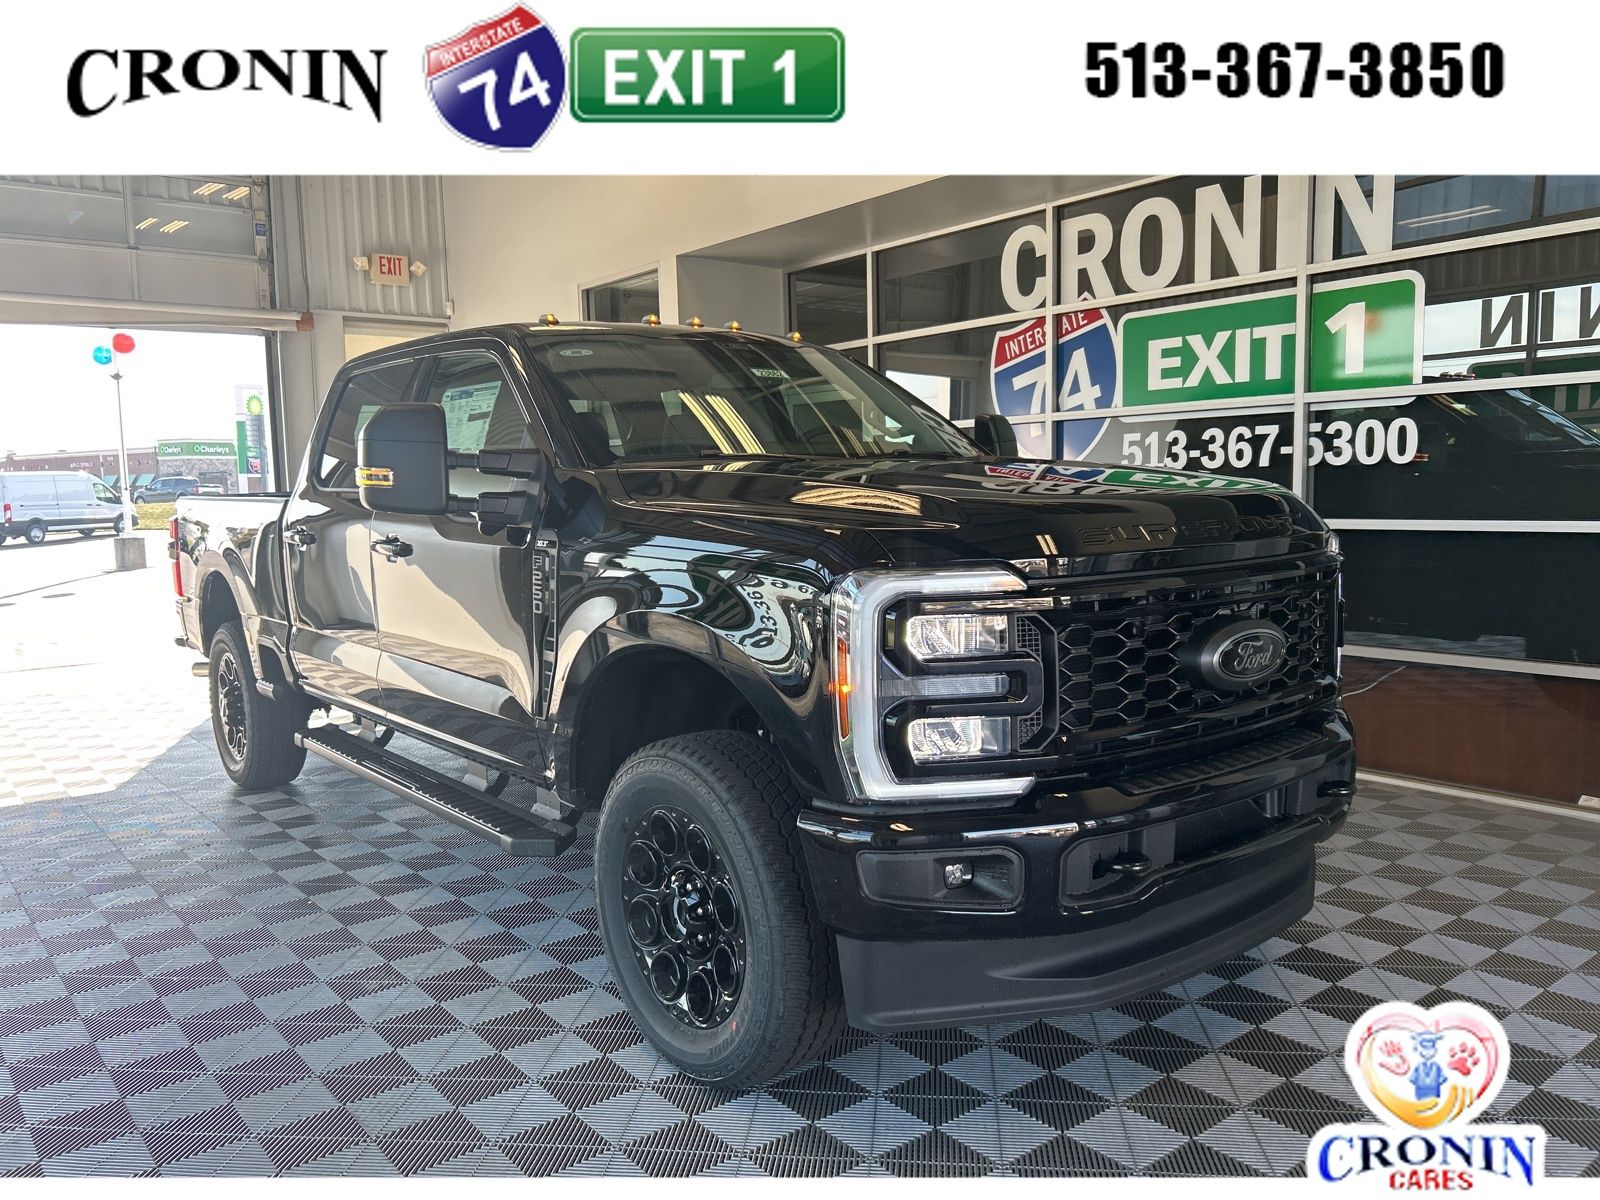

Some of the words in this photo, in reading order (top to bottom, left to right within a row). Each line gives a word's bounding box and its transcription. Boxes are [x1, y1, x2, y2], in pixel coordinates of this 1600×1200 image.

[379, 255, 402, 277] EXIT
[1001, 174, 1394, 311] CRONIN
[1004, 312, 1088, 360] INTERATE
[1147, 322, 1296, 392] EXIT
[1325, 302, 1369, 375] 1
[1012, 347, 1102, 439] 74
[1121, 417, 1418, 470] 513-367-5300
[1234, 640, 1274, 671] Ford
